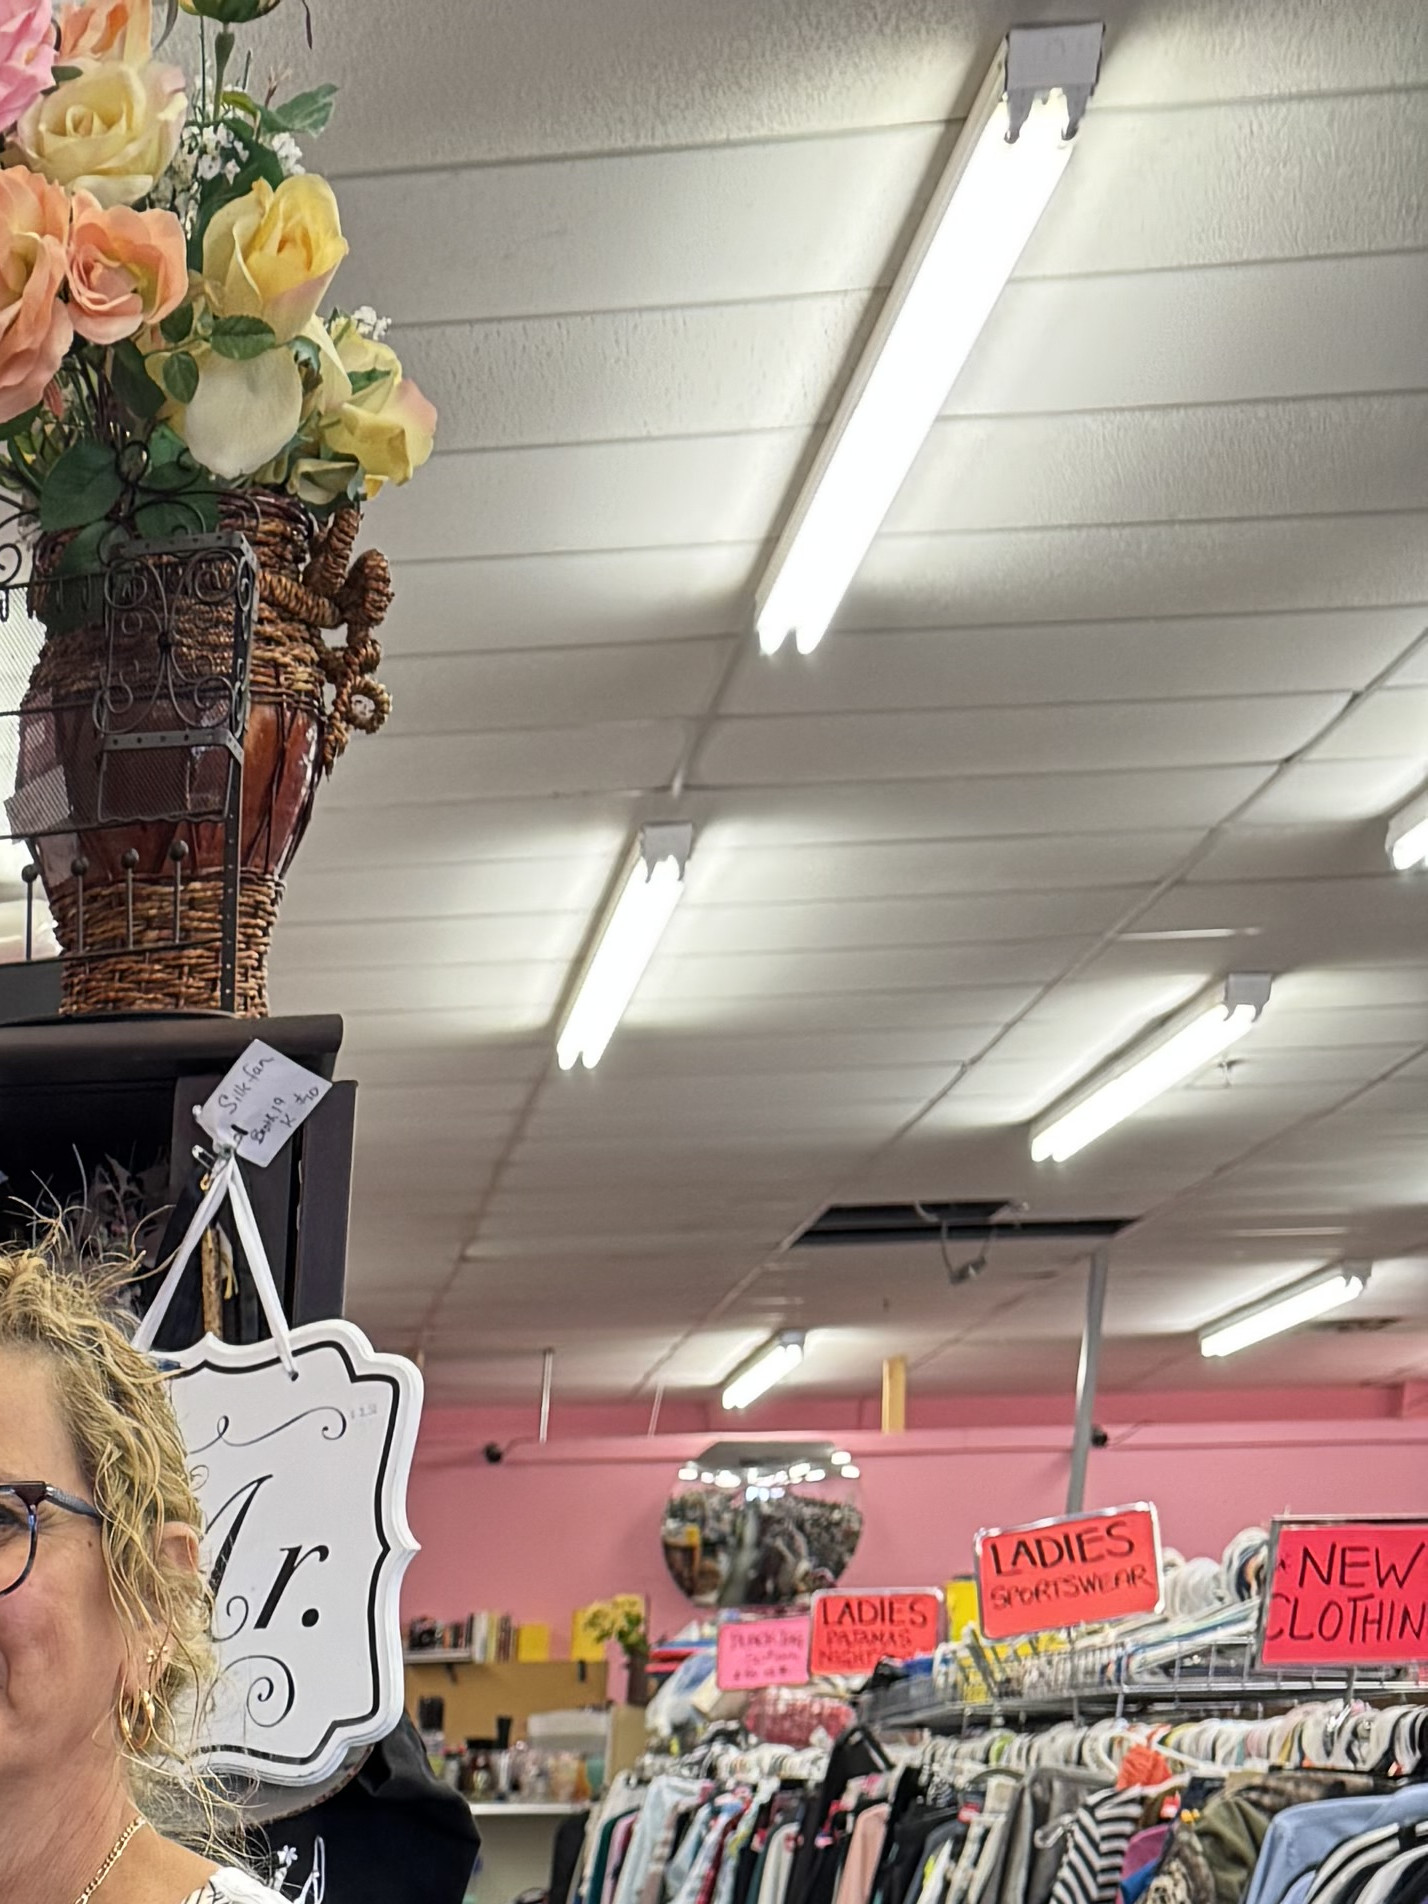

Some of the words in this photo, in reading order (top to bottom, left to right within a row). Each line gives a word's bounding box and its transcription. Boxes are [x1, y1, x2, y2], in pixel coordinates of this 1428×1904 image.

[990, 1519, 1135, 1577] LADIES
[1298, 1541, 1426, 1589] NEW
[990, 1563, 1154, 1610] SPORTSWEAR
[822, 1598, 928, 1628] LADIES
[1266, 1592, 1428, 1644] CLOTHIN
